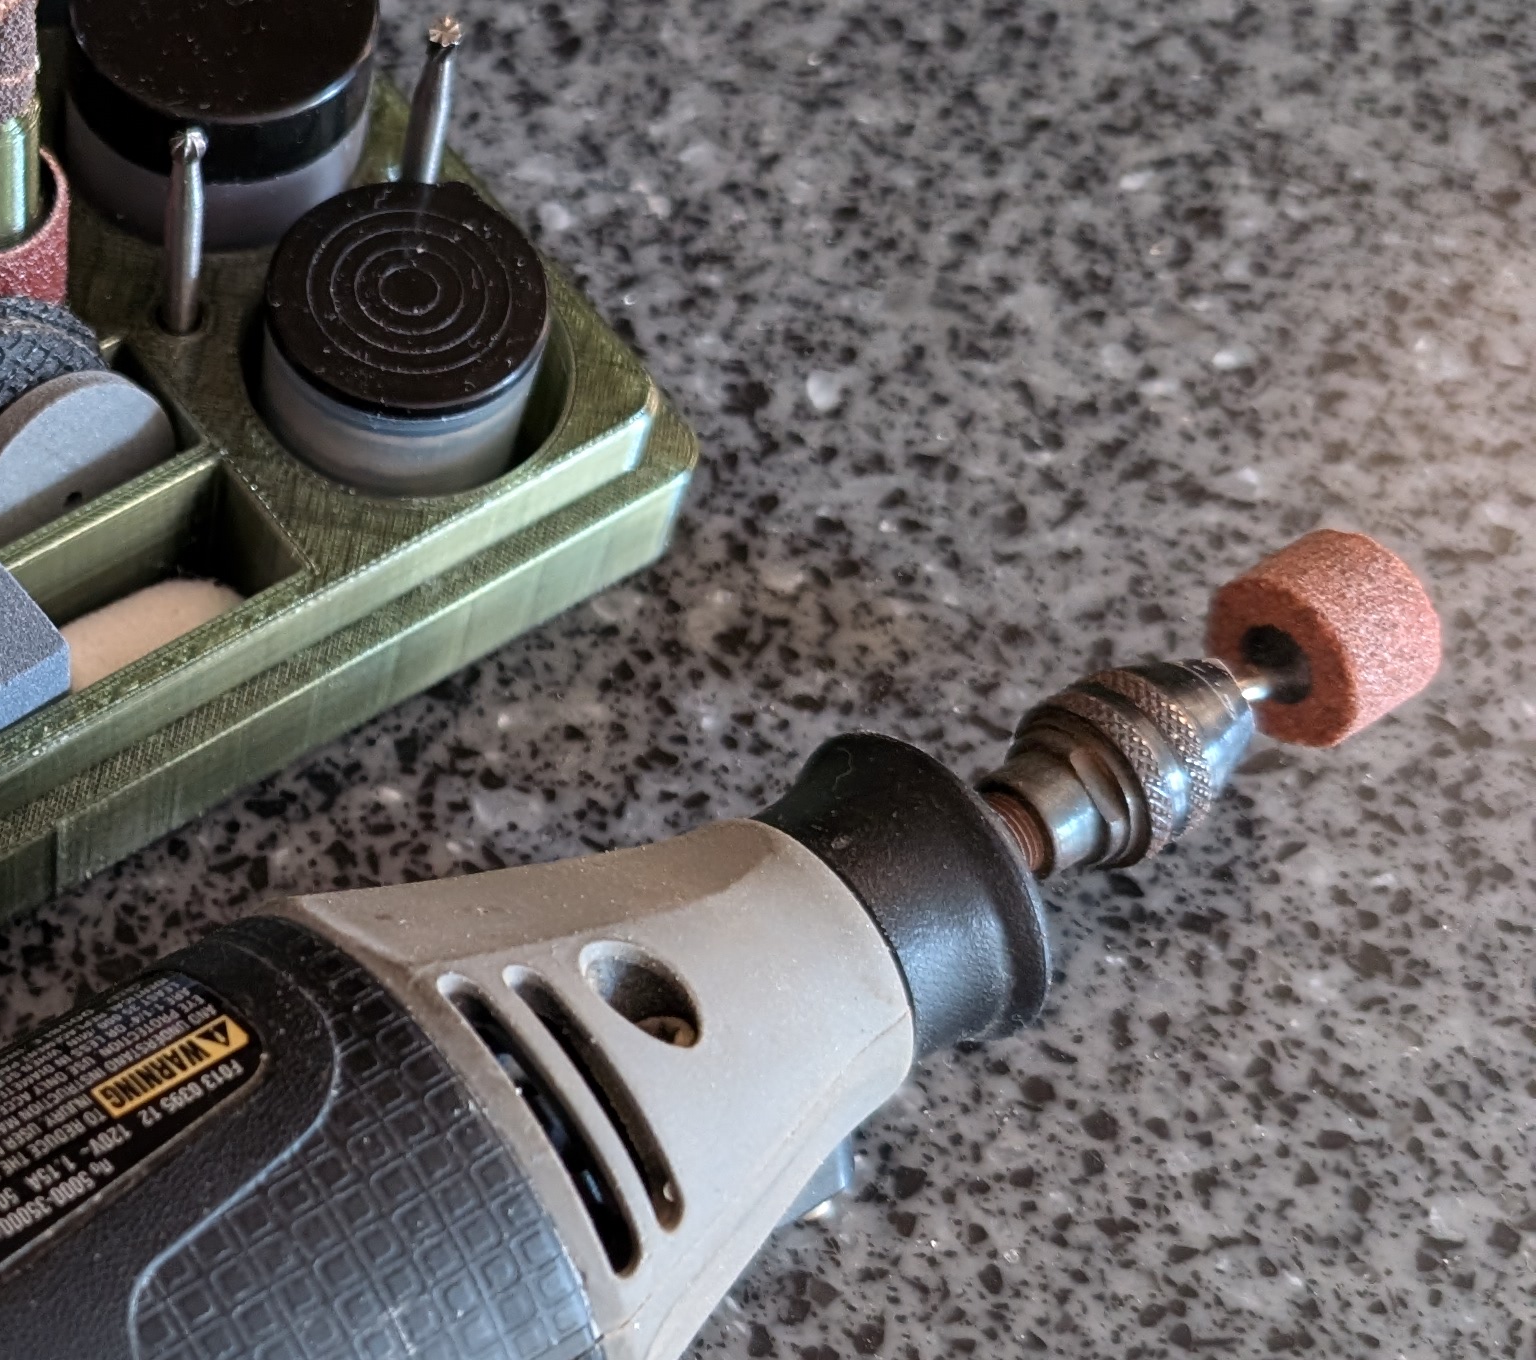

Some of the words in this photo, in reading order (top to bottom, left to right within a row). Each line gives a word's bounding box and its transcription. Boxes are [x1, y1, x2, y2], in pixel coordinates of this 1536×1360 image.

[176, 993, 205, 1013] EYE
[187, 1003, 216, 1025] AND
[104, 1020, 189, 1072] UNDERSTAND
[66, 1055, 96, 1075] USE
[100, 1040, 208, 1107] WARNING
[200, 1059, 243, 1090] F013
[18, 1067, 106, 1120] INSTRUCTION
[33, 1071, 68, 1095] ONLY
[82, 1107, 107, 1126] TO
[137, 1105, 162, 1126] 12
[2, 1122, 41, 1149] USER
[27, 1118, 85, 1158] REDUCE
[24, 1155, 75, 1191] 1.15A
